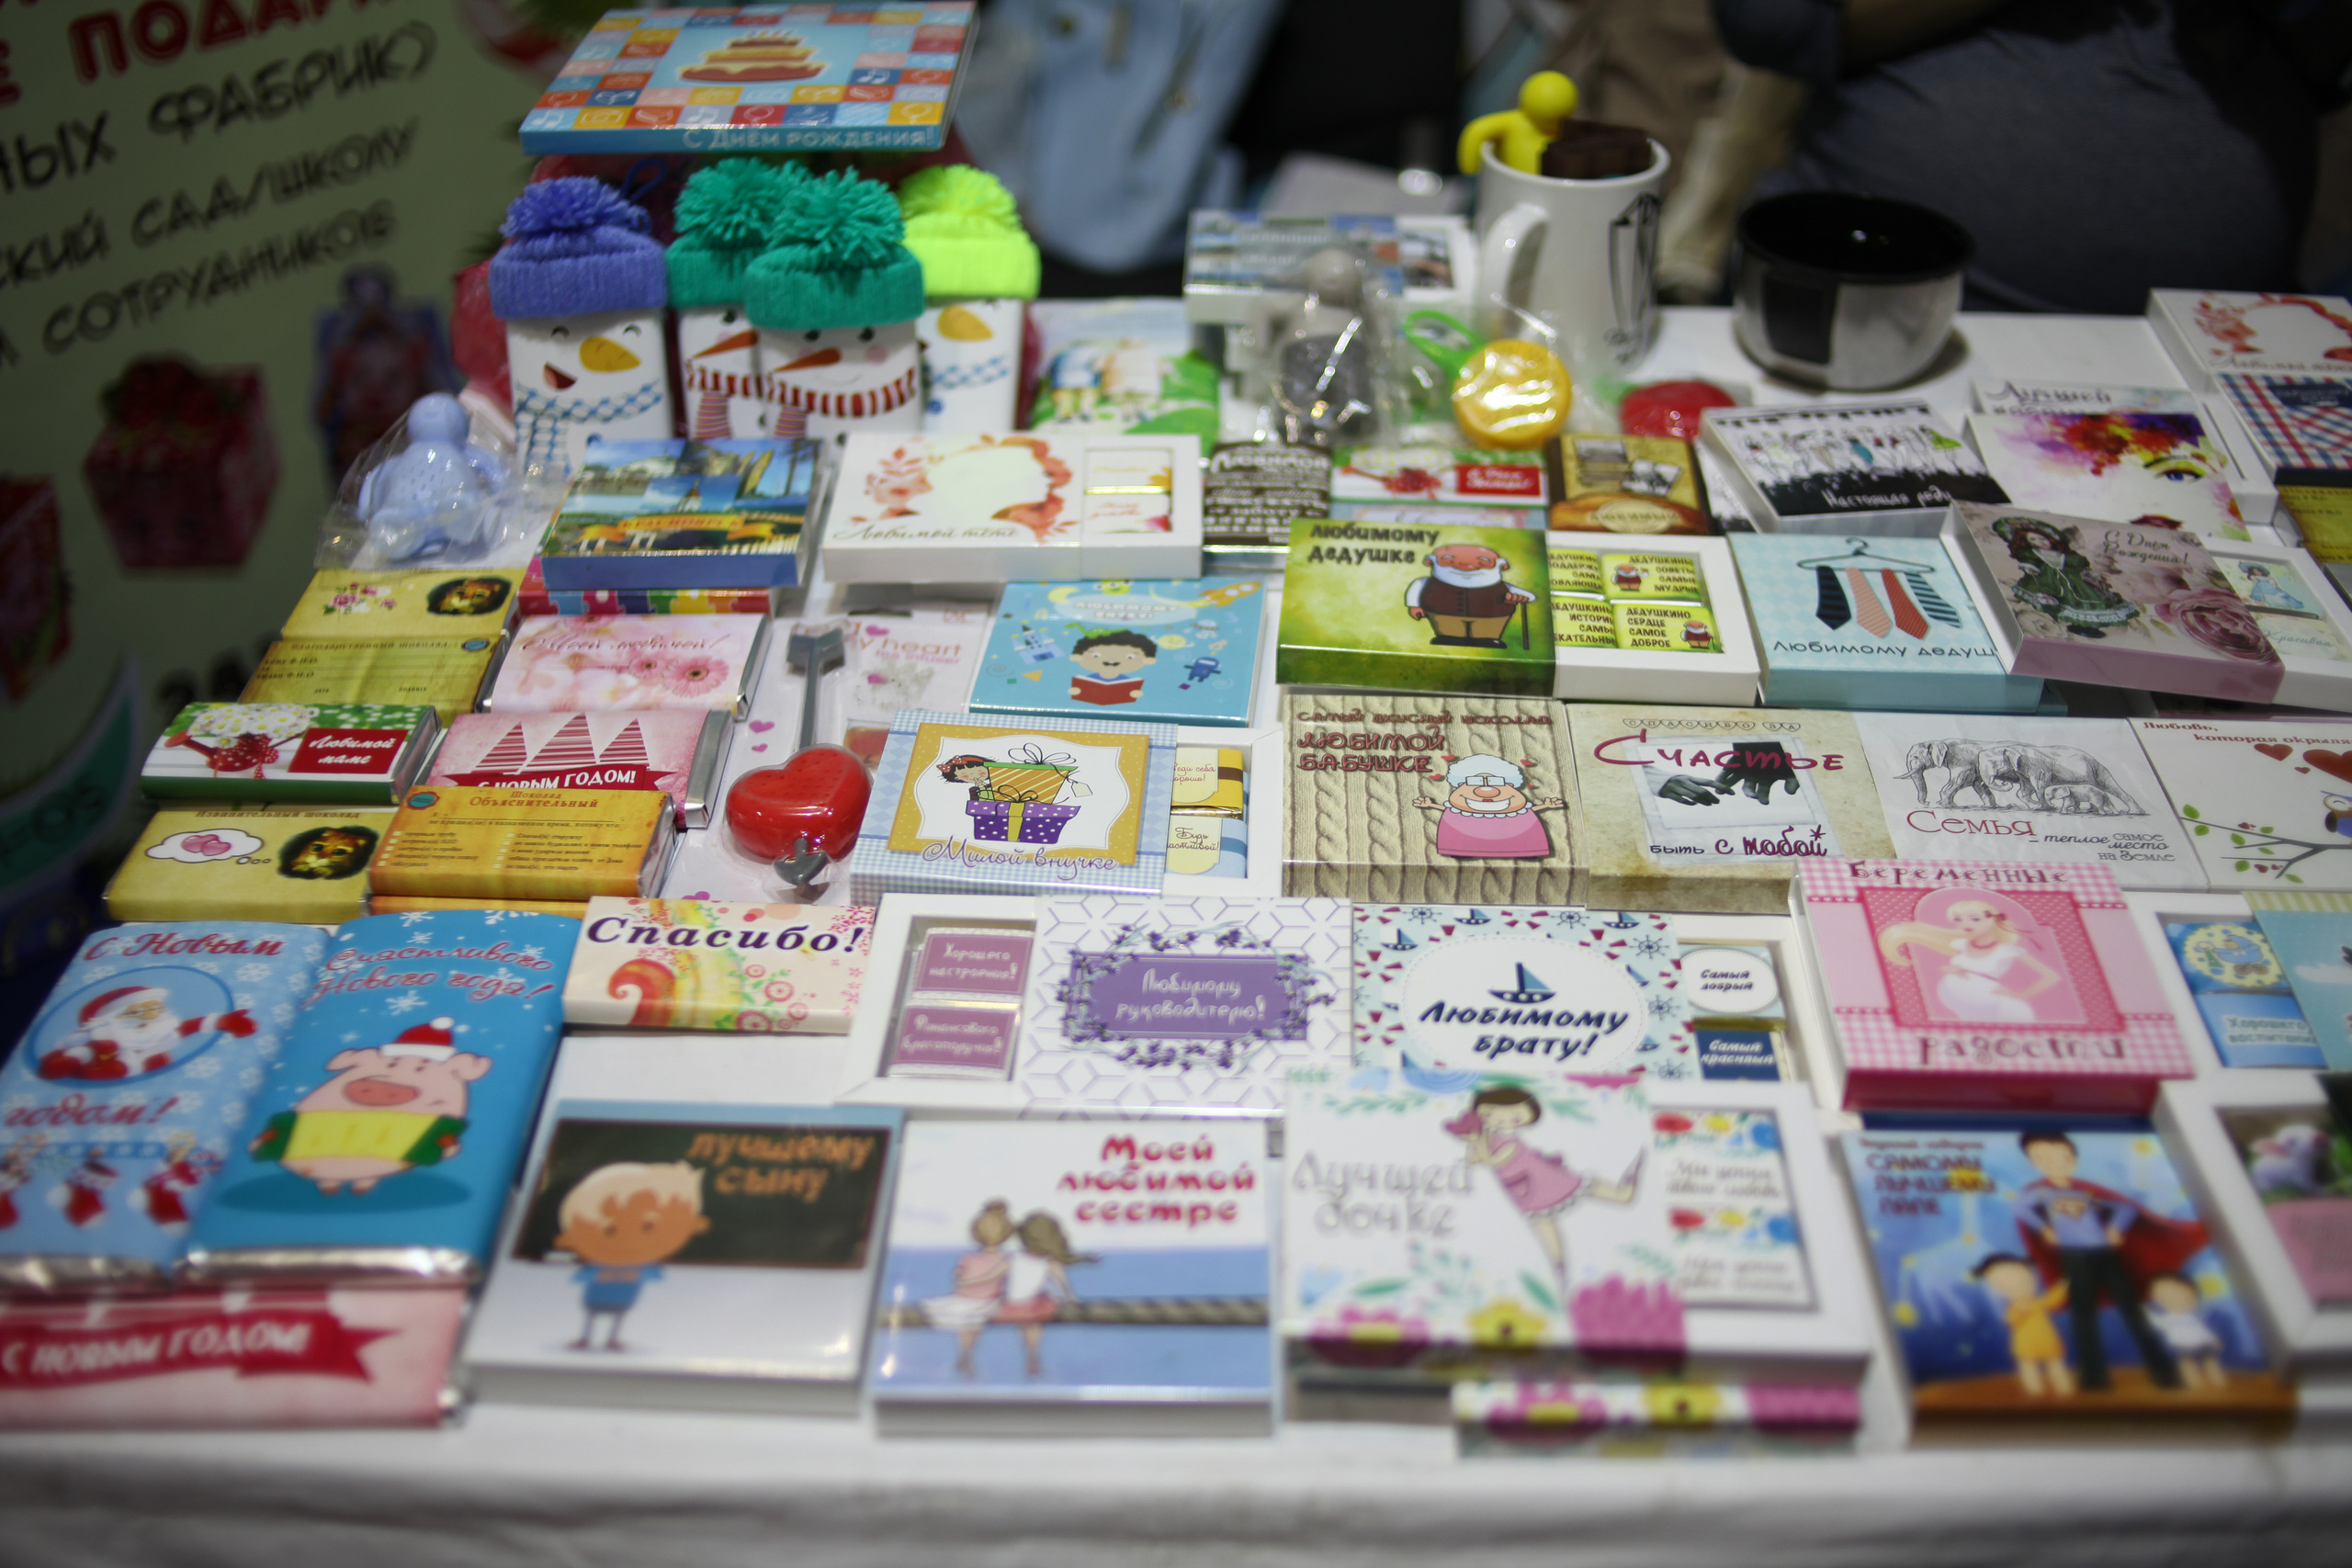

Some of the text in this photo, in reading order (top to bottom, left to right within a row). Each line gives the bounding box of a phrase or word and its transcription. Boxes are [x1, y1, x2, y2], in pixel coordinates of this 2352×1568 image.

[2193, 733, 2352, 745] которая окрыля
[318, 754, 371, 764] маме
[1296, 753, 1432, 773] БАБУШКЕ
[564, 770, 637, 787] ГОДОМ!
[1905, 810, 2038, 838] Семья
[922, 834, 1118, 881] Милой внучке
[85, 932, 284, 961] С Новым
[586, 917, 864, 953] Спасибо!
[324, 942, 553, 972] Счастливого
[304, 966, 555, 1009] Нового года!
[1700, 969, 1750, 979] Самый
[1419, 999, 1630, 1033] Любимому
[1708, 1039, 1763, 1053] Самый
[1101, 1132, 1215, 1161] Моей
[1057, 1160, 1256, 1191] любимой
[1075, 1201, 1238, 1228] сестре
